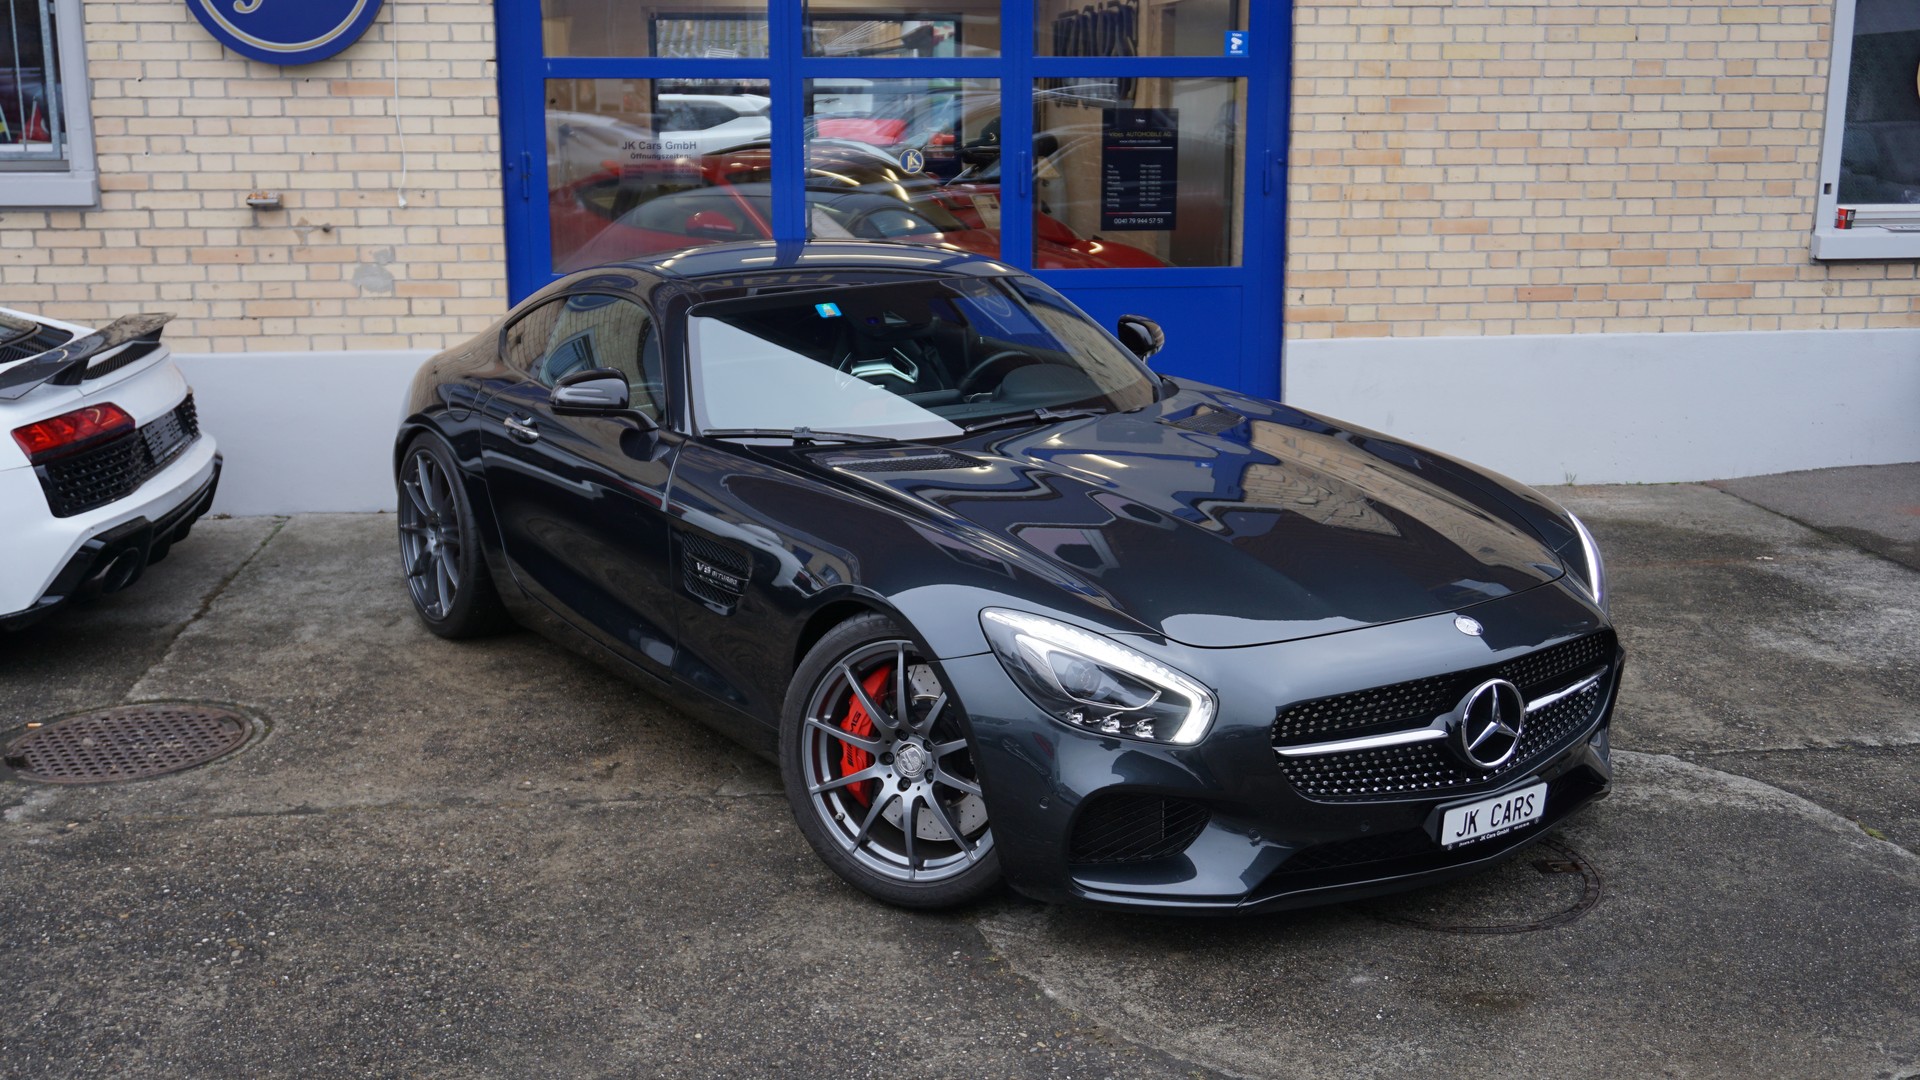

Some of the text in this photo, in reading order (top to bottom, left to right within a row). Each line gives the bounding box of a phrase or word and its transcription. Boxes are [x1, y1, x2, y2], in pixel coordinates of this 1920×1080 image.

[622, 141, 697, 150] JK Cars GmbH
[696, 562, 711, 574] V8
[1456, 793, 1535, 837] JK CARS
[1496, 828, 1510, 836] GmbH
